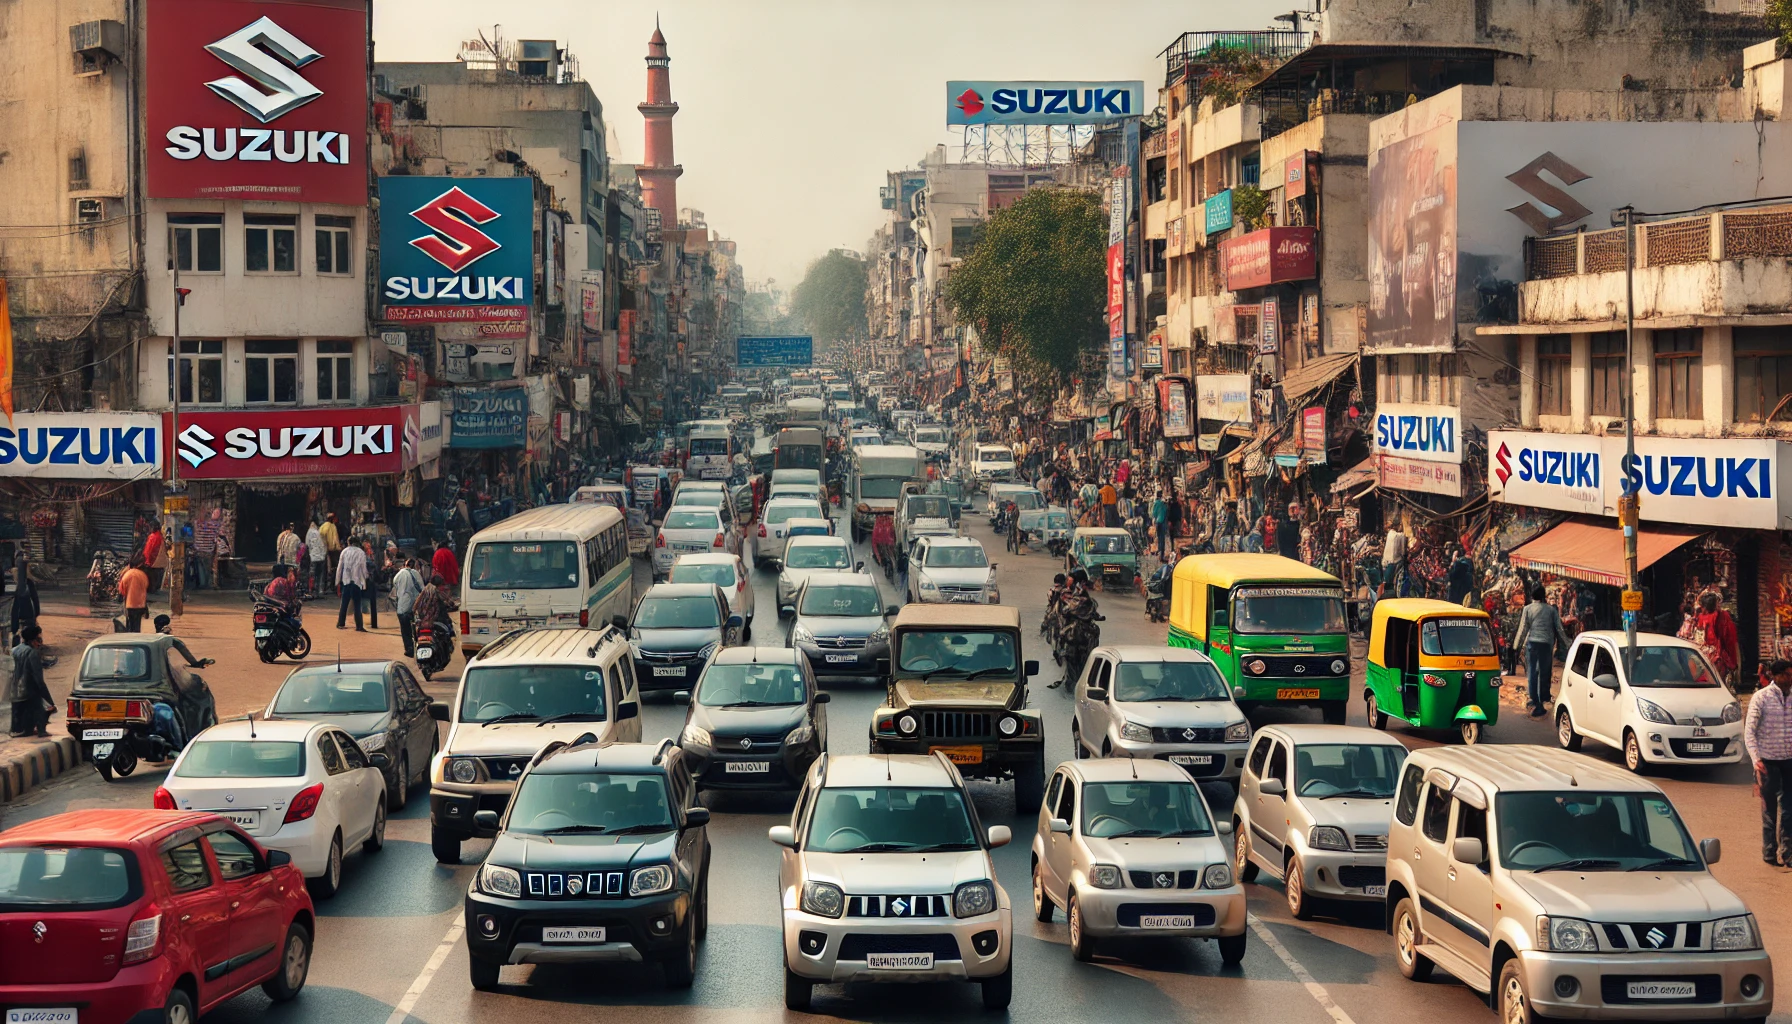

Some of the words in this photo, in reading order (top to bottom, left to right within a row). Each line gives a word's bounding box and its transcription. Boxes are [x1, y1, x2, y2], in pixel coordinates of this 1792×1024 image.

[991, 88, 1131, 114] SUZUKI
[165, 126, 349, 164] SUZUKI
[386, 277, 523, 299] SUZUKI
[0, 427, 156, 464] SUZUKI
[225, 425, 393, 459] SUZUKI
[1377, 414, 1454, 453] SUZUKI
[1519, 448, 1600, 489] SUZUKI
[1620, 453, 1771, 498] SUZUKI
